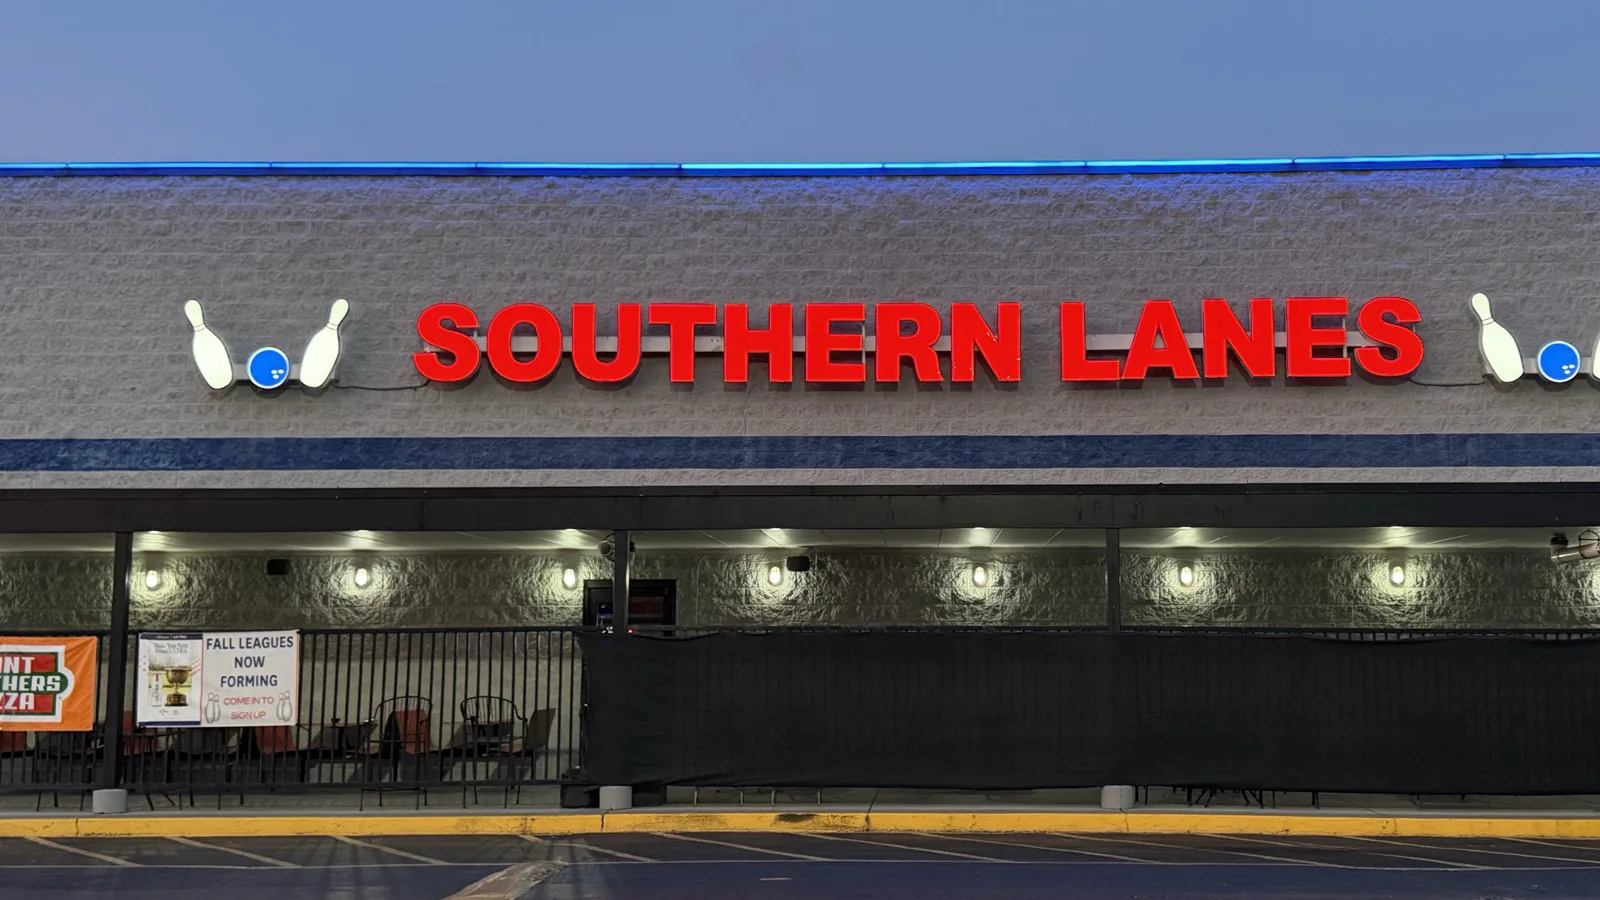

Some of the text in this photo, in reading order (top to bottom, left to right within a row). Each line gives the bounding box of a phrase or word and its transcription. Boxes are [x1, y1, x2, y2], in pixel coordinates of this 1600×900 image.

[413, 296, 1425, 383] SOUTHERN LANES
[206, 635, 294, 650] FALL LEAGUES
[234, 656, 265, 668] NOW
[0, 675, 61, 692] HERS
[220, 674, 278, 688] FORMING
[223, 696, 274, 706] COME IN TO
[231, 711, 267, 720] SIGN UP
